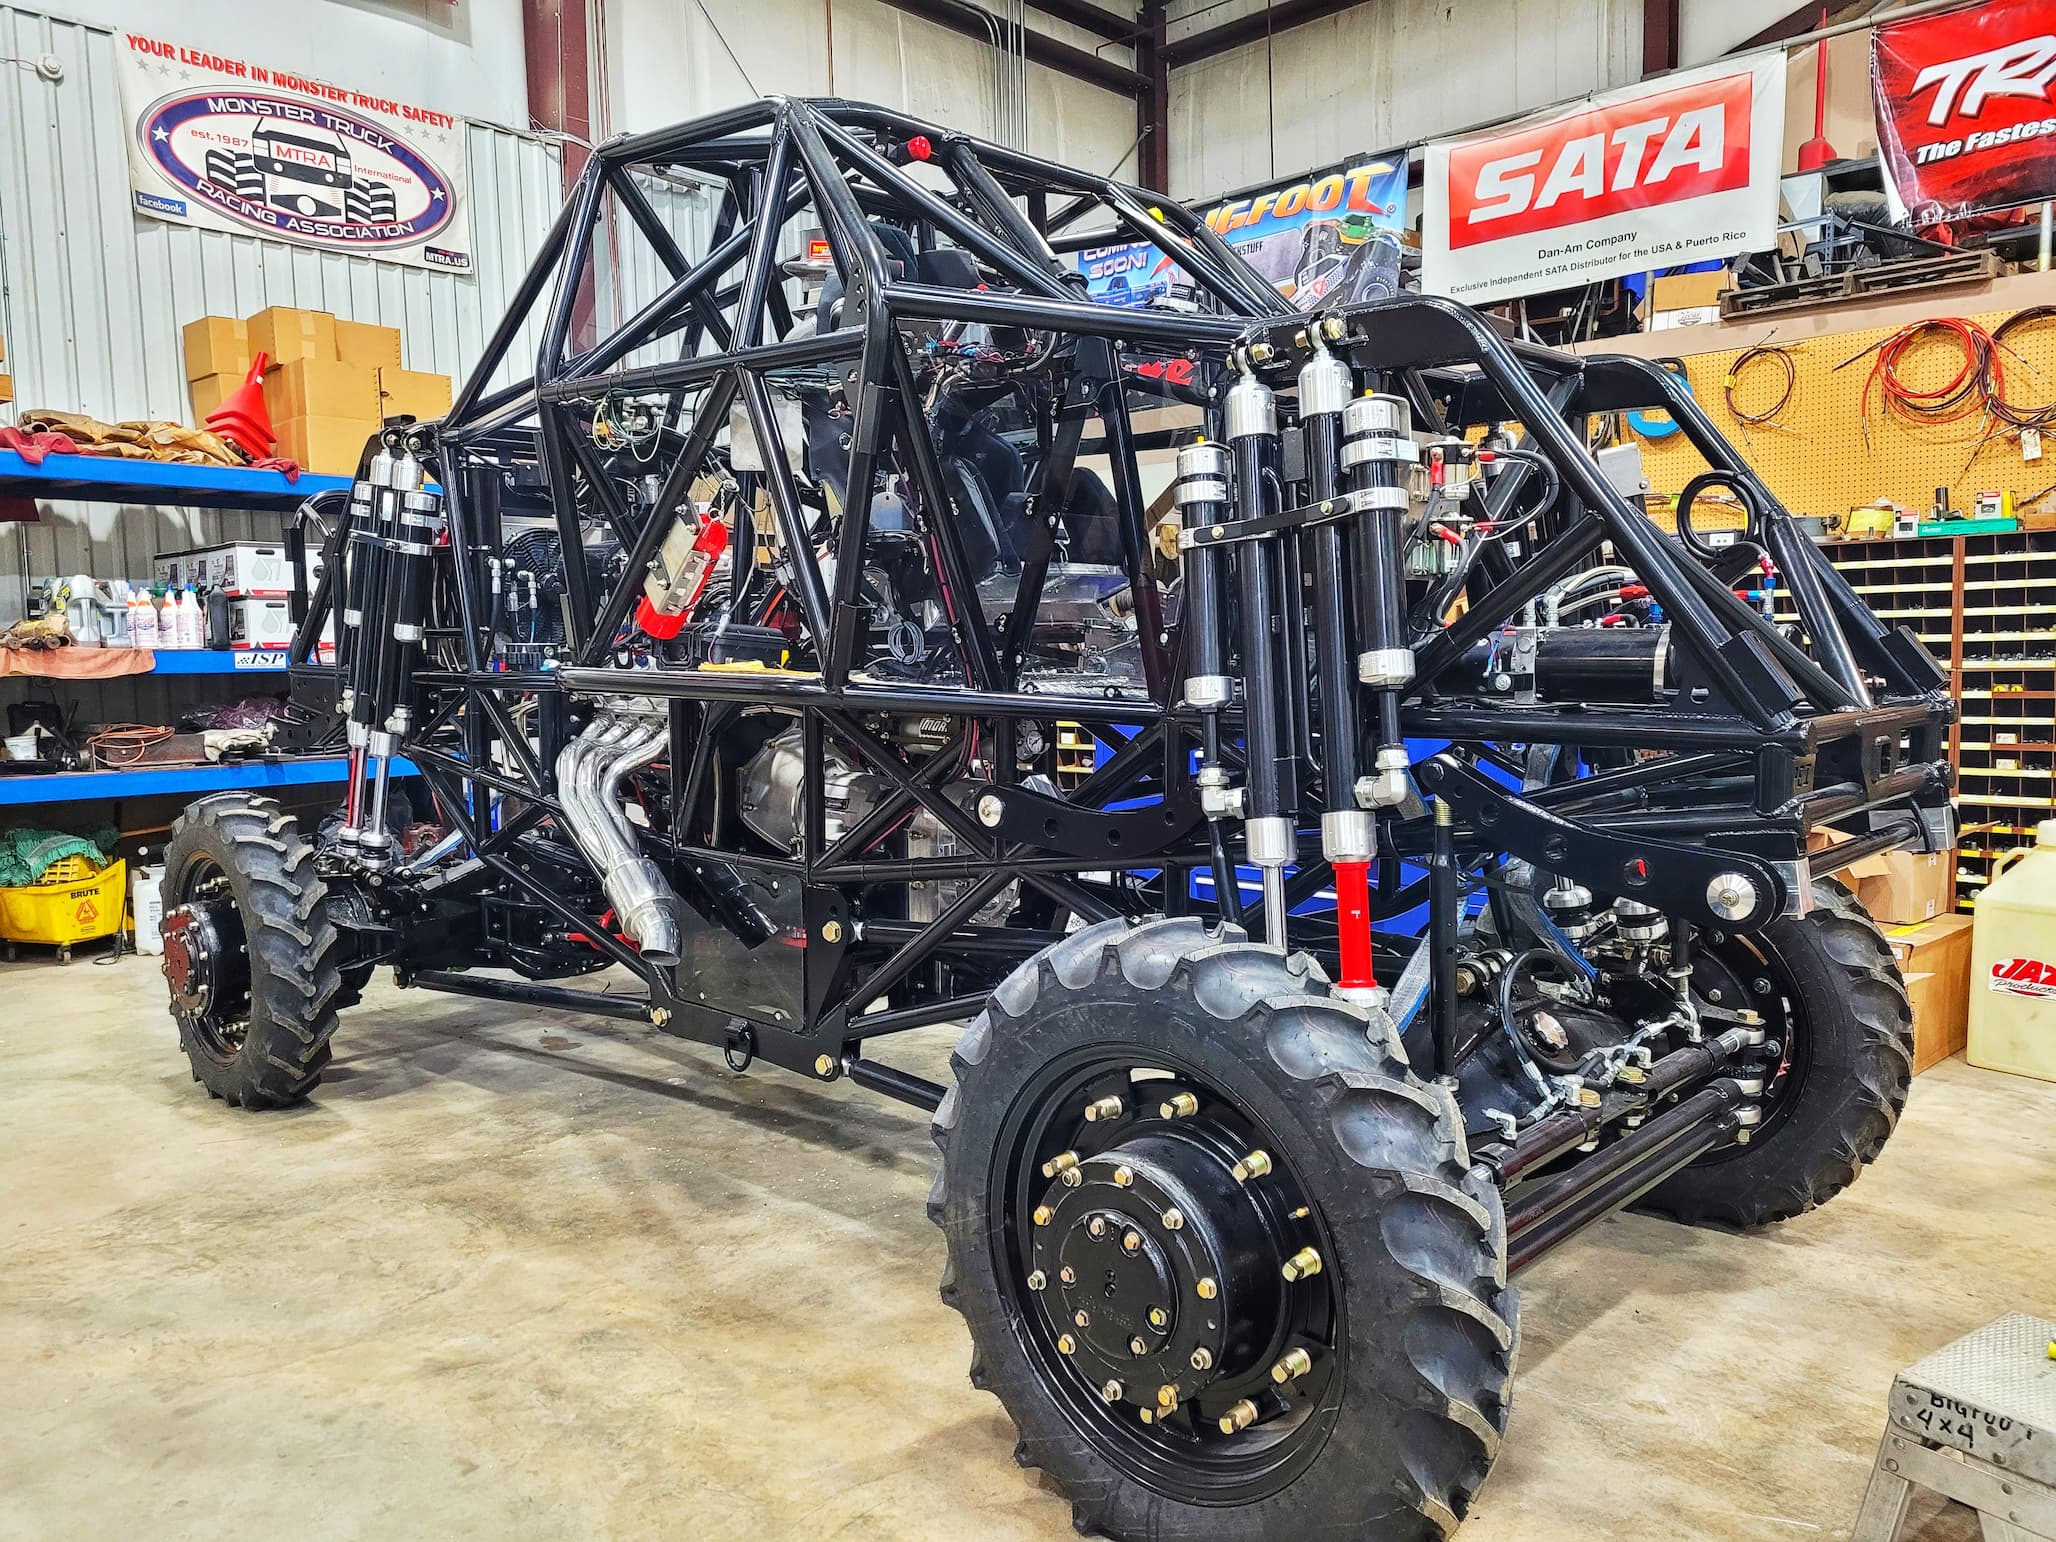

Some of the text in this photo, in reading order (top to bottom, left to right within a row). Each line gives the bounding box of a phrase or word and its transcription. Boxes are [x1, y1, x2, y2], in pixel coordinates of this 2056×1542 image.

[126, 34, 454, 129] YOUR LEADER IN MONSTER TRUCK SAFETY
[1909, 35, 2056, 126] TR
[207, 98, 395, 154] MONSTER TRUCK
[276, 145, 331, 168] MTRA
[1467, 103, 1725, 225] SATA
[1917, 139, 1962, 164] The
[354, 165, 412, 184] International
[138, 195, 184, 214] facebook
[197, 179, 414, 239] RACING ASSOCIATION
[1204, 163, 1395, 237] IGFOOT
[426, 252, 468, 266] MTRA.US
[1538, 231, 1638, 259] Dan-Am Company
[1450, 231, 1746, 294] Exclusive Independent SATA Distributor for the USA & Puerto Rico
[250, 653, 284, 665] ISP
[71, 888, 100, 900] BRUTE
